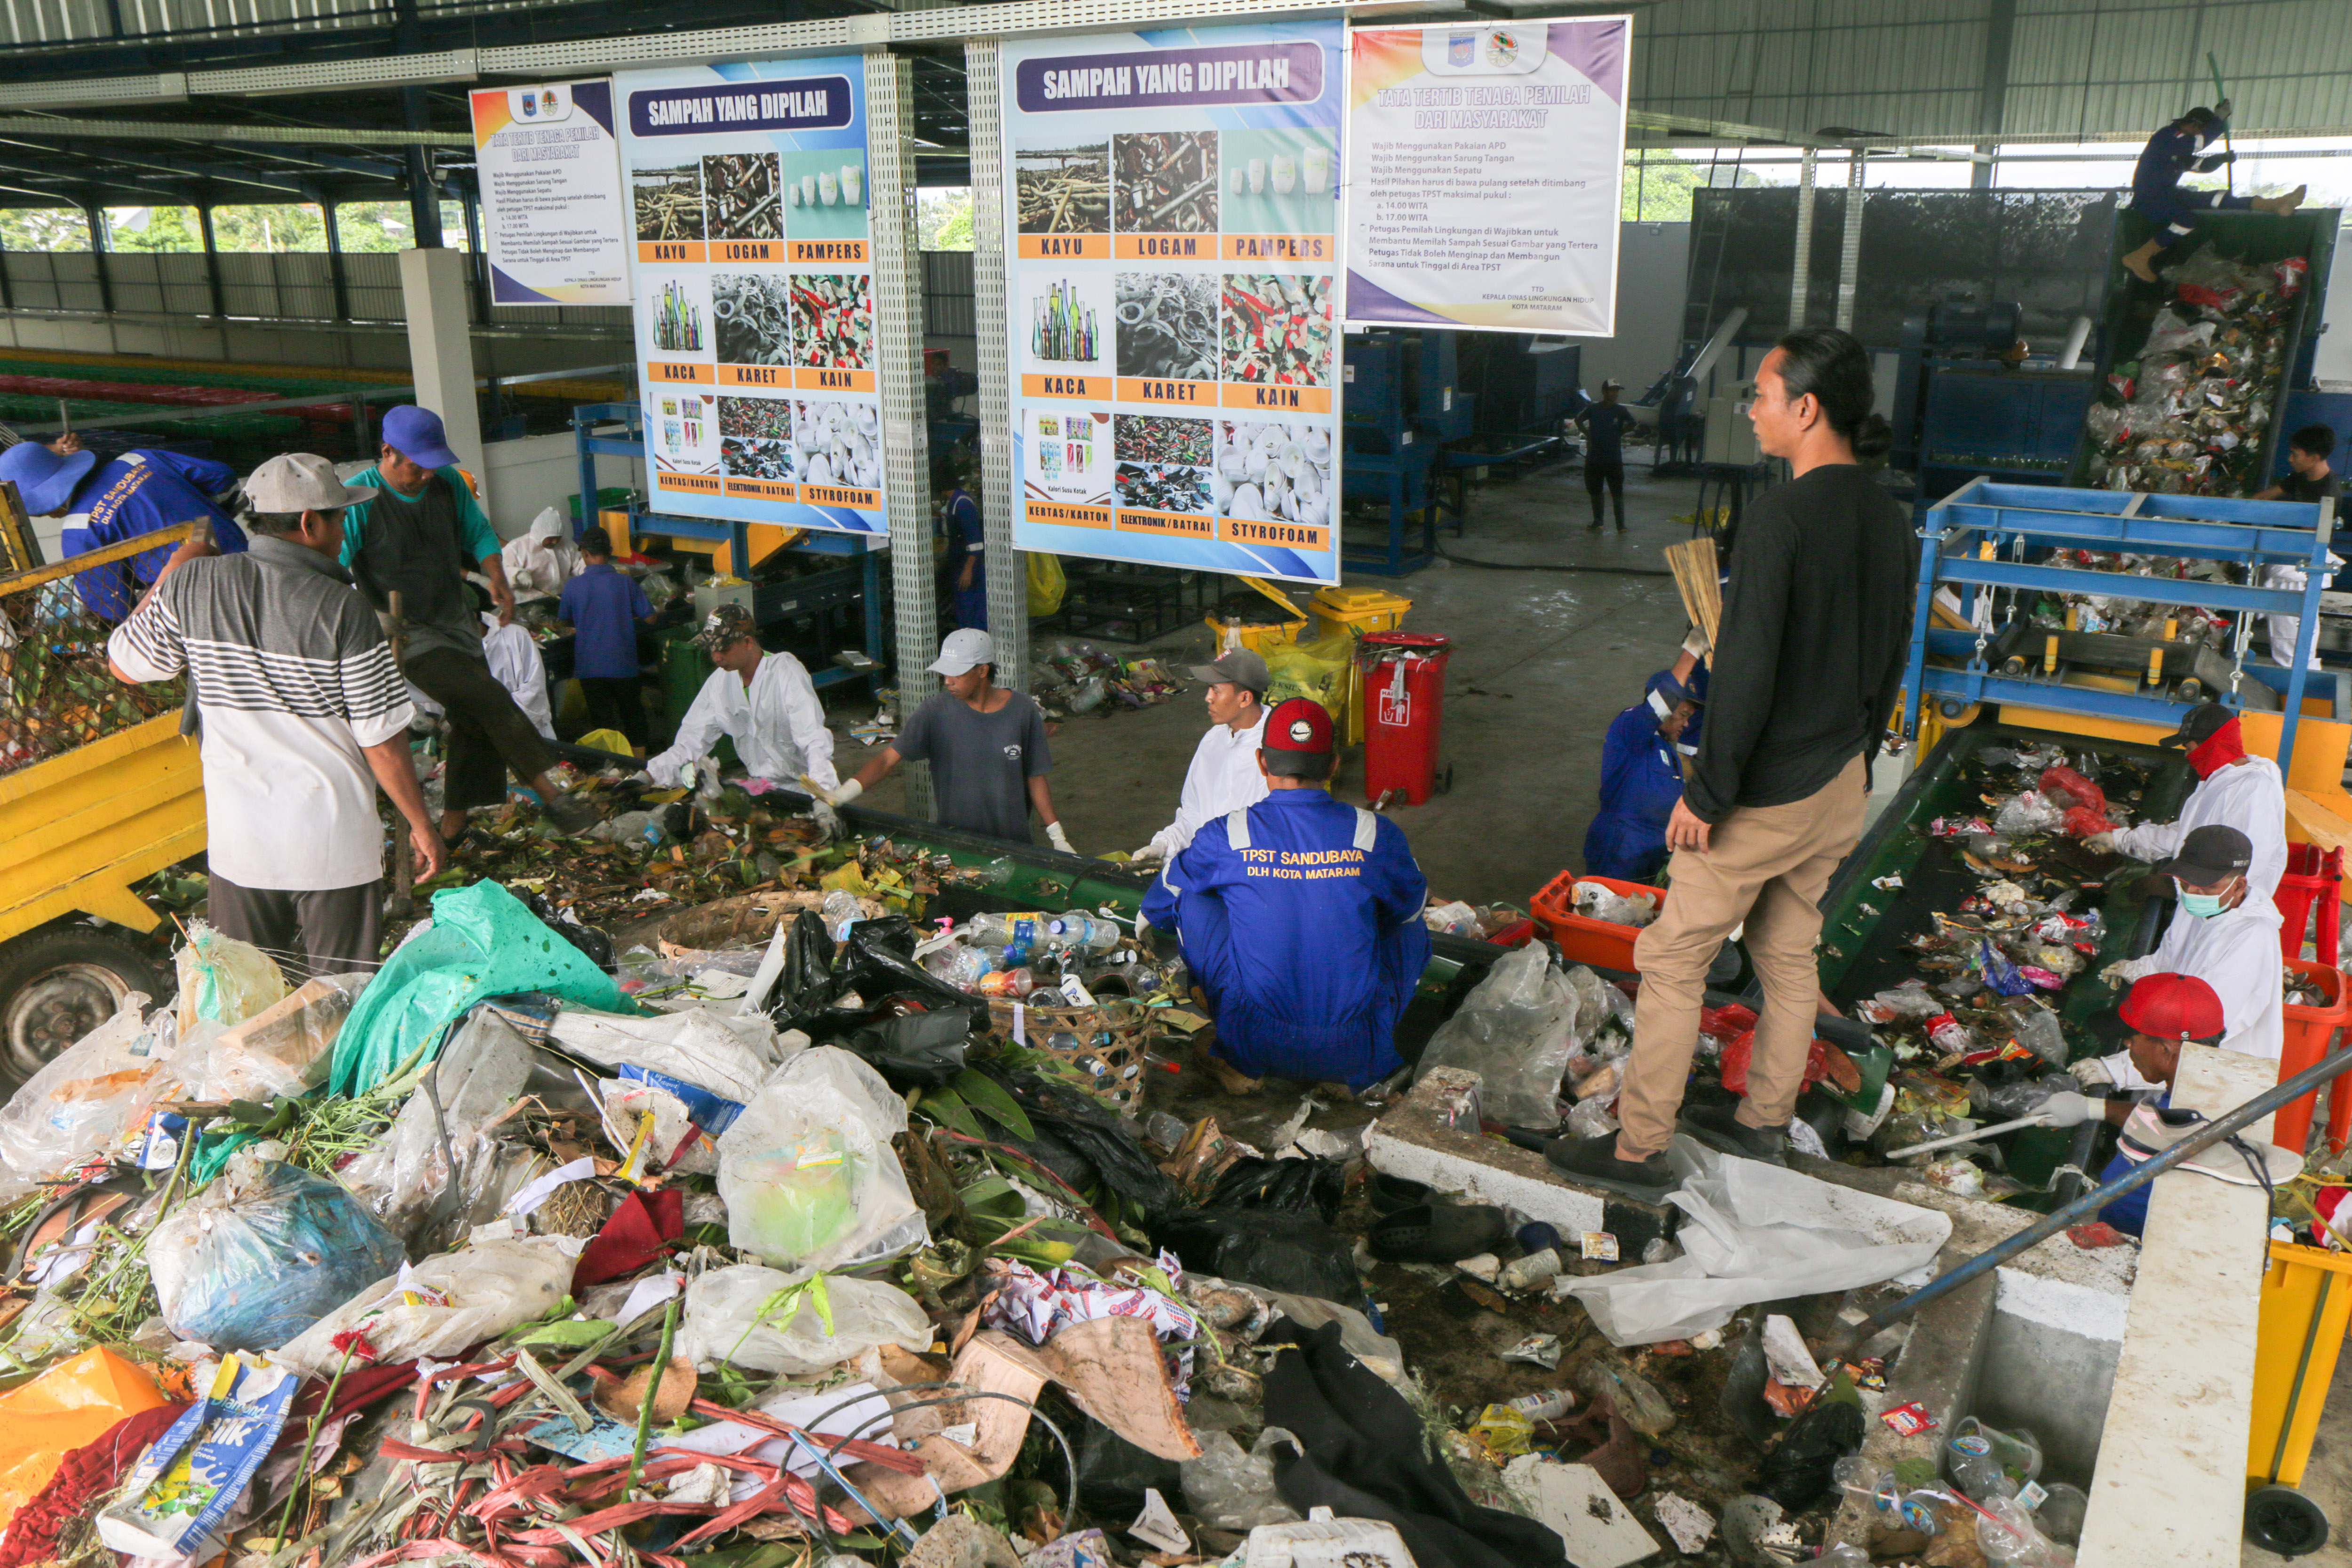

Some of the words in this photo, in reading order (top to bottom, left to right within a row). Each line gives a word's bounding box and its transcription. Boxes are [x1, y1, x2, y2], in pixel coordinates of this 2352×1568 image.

[1043, 66, 1130, 99] SAMPAH
[1136, 63, 1192, 94] YANG
[1198, 58, 1289, 92] DIPILAH
[1377, 88, 1412, 107] TATA
[1413, 87, 1462, 107] TERTIB
[1464, 86, 1522, 106] TENAGA
[1524, 84, 1591, 105] PEMILAH
[649, 98, 713, 126] SAMPAH
[715, 95, 758, 121] YANG
[761, 90, 827, 119] DIPILAH
[1414, 110, 1448, 129] DARI
[1450, 109, 1549, 129] MASYARAKAT
[489, 133, 509, 147] TATA
[508, 131, 535, 146] TERTIB
[534, 128, 565, 144] TENAGA
[564, 125, 599, 143] PEMILAH
[511, 148, 530, 162] DARI
[529, 144, 580, 161] MASYARAKAT
[1372, 142, 1394, 151] Wajib
[1395, 142, 1453, 151] Menggunakan
[1371, 154, 1393, 163] Wajib
[1395, 154, 1452, 163] Menggunakan
[1454, 154, 1483, 164] Sarung
[1484, 154, 1514, 164] Tangan
[1371, 166, 1393, 175] Wajib
[1395, 166, 1451, 175] Menggunakan
[1453, 166, 1481, 175] Sepatu
[1478, 178, 1508, 188] pulang
[1542, 178, 1586, 189] ditimbang
[1389, 191, 1420, 199] petugas
[1483, 191, 1507, 200] pukul
[1369, 224, 1400, 234] Petugas
[1435, 226, 1482, 236] Lingkungan
[1494, 227, 1532, 237] Wajibkan
[1042, 239, 1081, 254] KAYU
[1139, 239, 1195, 255] LOGAM
[1237, 239, 1321, 256] PAMPERS
[1369, 236, 1411, 245] Membantu
[1413, 237, 1446, 246] Memilah
[1448, 238, 1481, 247] Sampah
[1510, 239, 1544, 248] Gambar
[1568, 241, 1598, 249] Tertera
[655, 245, 685, 259] KAYU
[727, 245, 768, 258] LOGAM
[798, 244, 860, 258] PAMPERS
[1369, 248, 1399, 257] Petugas
[1448, 250, 1488, 261] Menginap
[1507, 252, 1560, 262] Membangun
[1421, 261, 1450, 271] Tinggal
[665, 365, 695, 379] KACA
[738, 368, 775, 383] KARET
[820, 372, 851, 386] KAIN
[1045, 378, 1085, 394] KACA
[1144, 382, 1195, 400] KARET
[1257, 389, 1298, 406] KAIN
[660, 476, 719, 489] KERTAS/KARTON
[810, 488, 873, 505] STYROFOAM
[101, 509, 114, 524] DLH
[1030, 506, 1108, 521] KERTAS/KARTON
[1232, 523, 1318, 544] STYROFOAM
[1240, 849, 1276, 862] TPST
[1280, 850, 1365, 865] SANDUBAYA
[1248, 867, 1269, 876] DLH
[1273, 868, 1302, 879] KOTA
[1306, 868, 1360, 879] MATARAM
[212, 1417, 252, 1447] ilk
